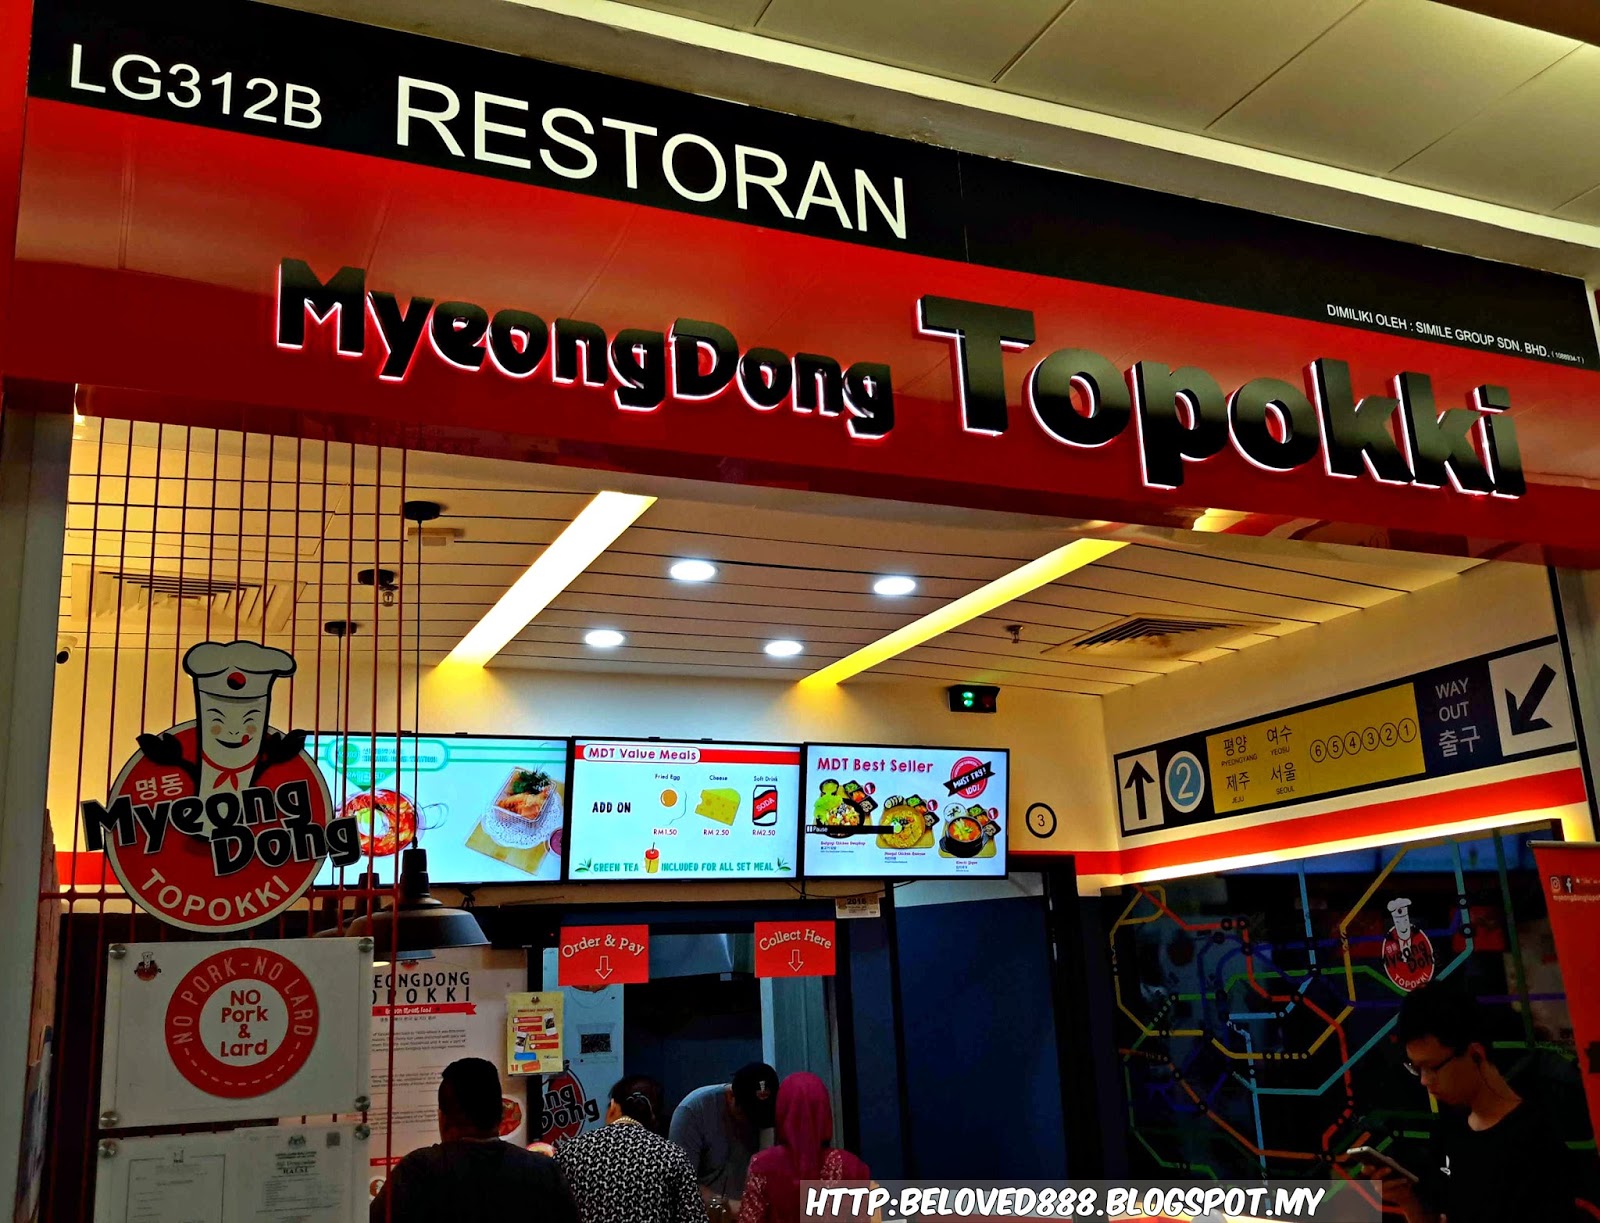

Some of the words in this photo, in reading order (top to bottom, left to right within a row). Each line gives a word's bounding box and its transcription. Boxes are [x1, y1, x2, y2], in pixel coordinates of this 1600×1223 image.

[69, 43, 324, 130] LG312B
[396, 75, 907, 240] RESTORAN
[1326, 303, 1374, 324] DIMILIKI
[1375, 313, 1408, 330] OLEH
[1415, 321, 1453, 339] SIMILE
[1455, 328, 1495, 346] GROUP
[1497, 336, 1523, 353] SDN.
[1524, 342, 1550, 359] BHD.
[276, 257, 895, 440] MyeongDong
[916, 294, 1527, 499] Topokki
[1435, 677, 1469, 701] WAY
[1438, 701, 1470, 722] OUT
[1223, 735, 1248, 756] 평양
[1266, 725, 1292, 745] 여수
[1438, 725, 1480, 758] 출구
[588, 746, 615, 758] MDT
[619, 747, 656, 760] Value
[659, 749, 697, 761] Meals
[1271, 746, 1290, 756] YEOSU
[817, 757, 849, 771] MDT
[853, 757, 885, 772] Best
[890, 758, 934, 774] Seller
[1270, 762, 1296, 783] 서울
[135, 773, 184, 801] 명동
[952, 775, 970, 789] MUST
[1175, 762, 1194, 799] 2
[1225, 771, 1250, 791] 제주
[1275, 786, 1295, 795] SEOUL
[592, 801, 613, 813] ADD
[616, 801, 631, 813] ON
[756, 797, 775, 812] SODA
[1232, 796, 1245, 804] JEJU
[80, 780, 311, 855] Myeong
[812, 825, 829, 833] Pause
[209, 815, 362, 877] Dong
[593, 862, 621, 872] GREEN
[623, 862, 639, 872] TEA
[660, 862, 699, 872] INCLUDED
[701, 862, 717, 872] FOR
[719, 862, 734, 872] ALL
[736, 861, 751, 871] SET
[753, 861, 774, 872] MEAL
[141, 868, 290, 921] TOPOKKI
[562, 937, 601, 957] Order
[604, 934, 616, 947] &
[618, 937, 645, 956] Pay
[760, 929, 801, 951] Collect
[804, 928, 832, 949] Here
[230, 989, 261, 1006] NO
[172, 1015, 193, 1045] NO
[284, 978, 314, 1036] LARD
[221, 1006, 269, 1023] Pork
[238, 1023, 251, 1039] &
[220, 1039, 268, 1057] Lard
